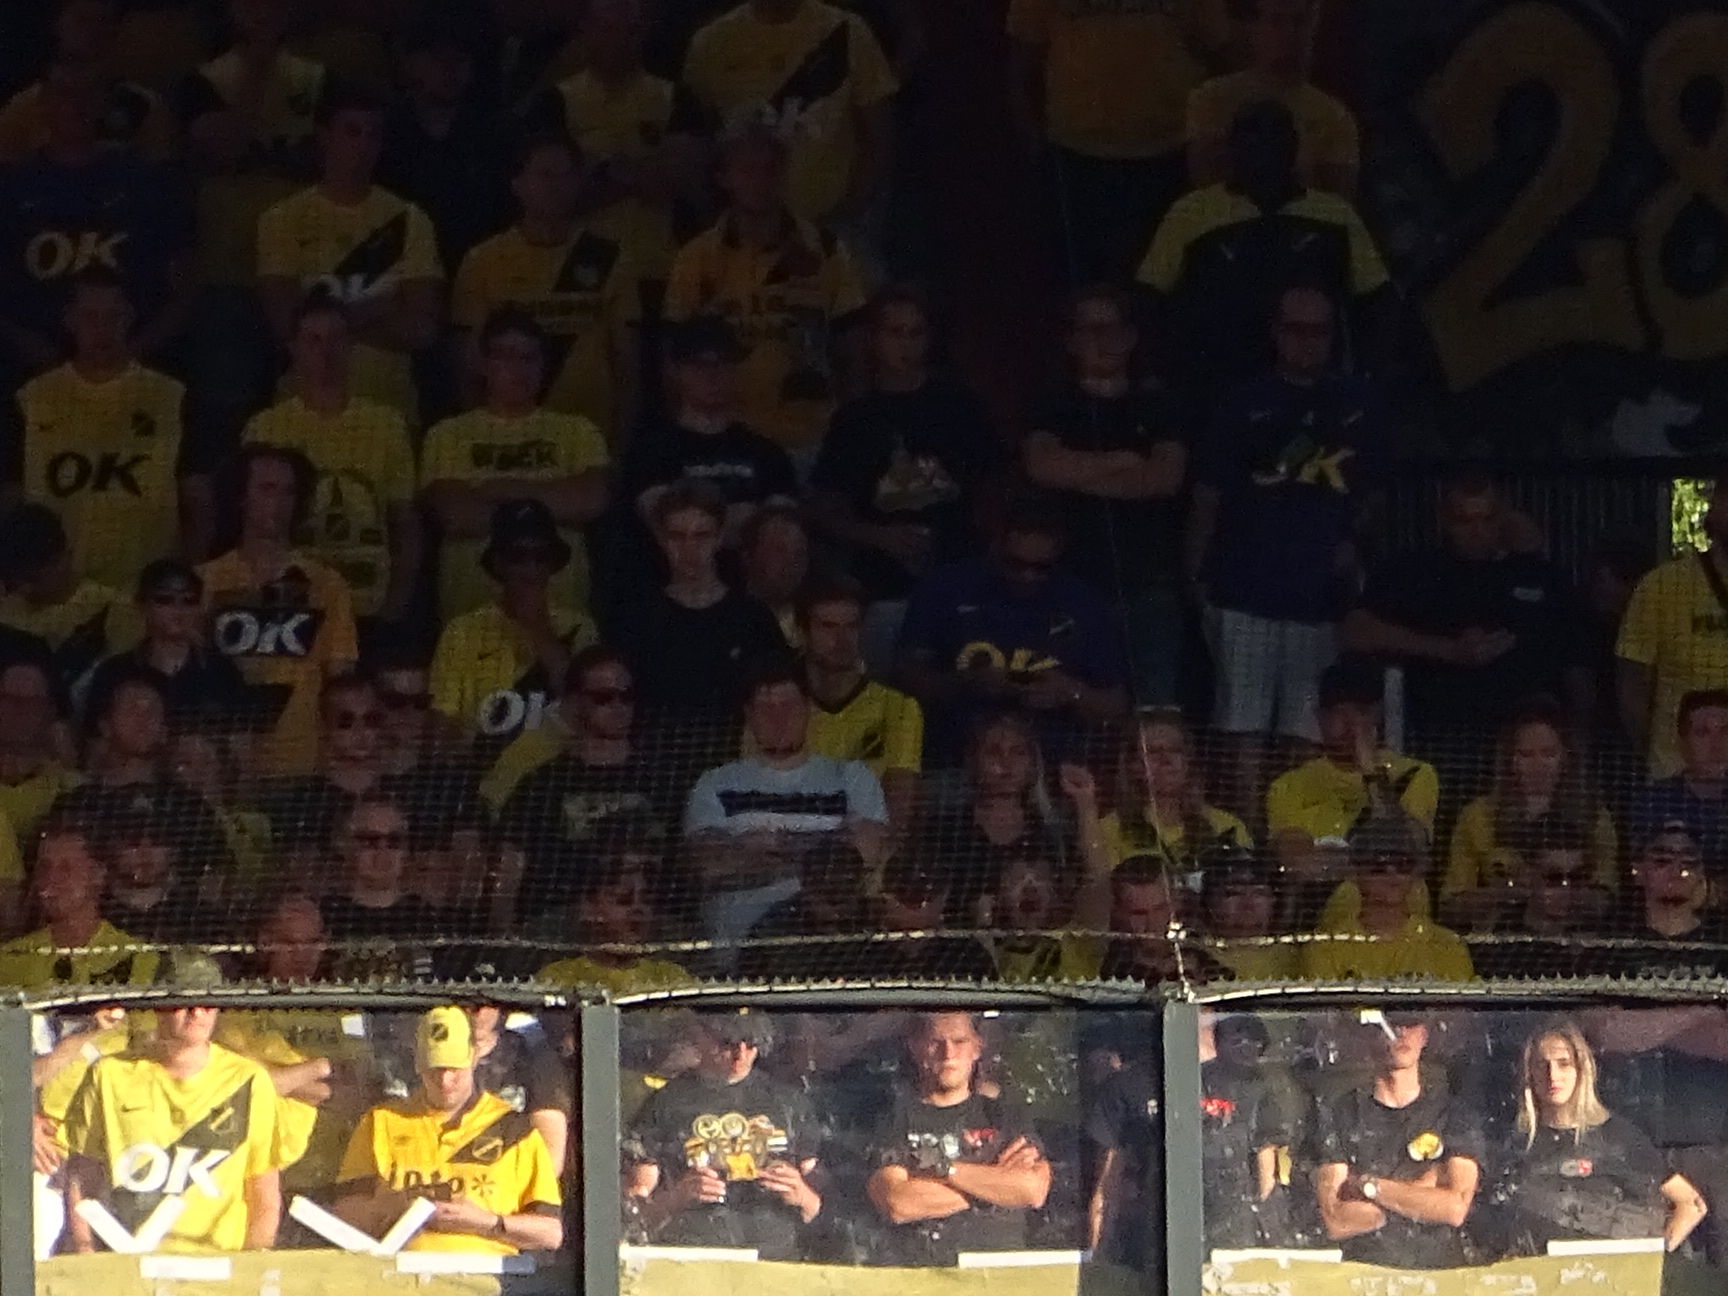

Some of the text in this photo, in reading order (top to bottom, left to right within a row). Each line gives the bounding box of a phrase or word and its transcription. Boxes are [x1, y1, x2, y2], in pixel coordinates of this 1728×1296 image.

[25, 231, 130, 278] OK
[46, 451, 150, 498] OK
[214, 610, 312, 656] OK
[121, 1142, 228, 1196] OK
